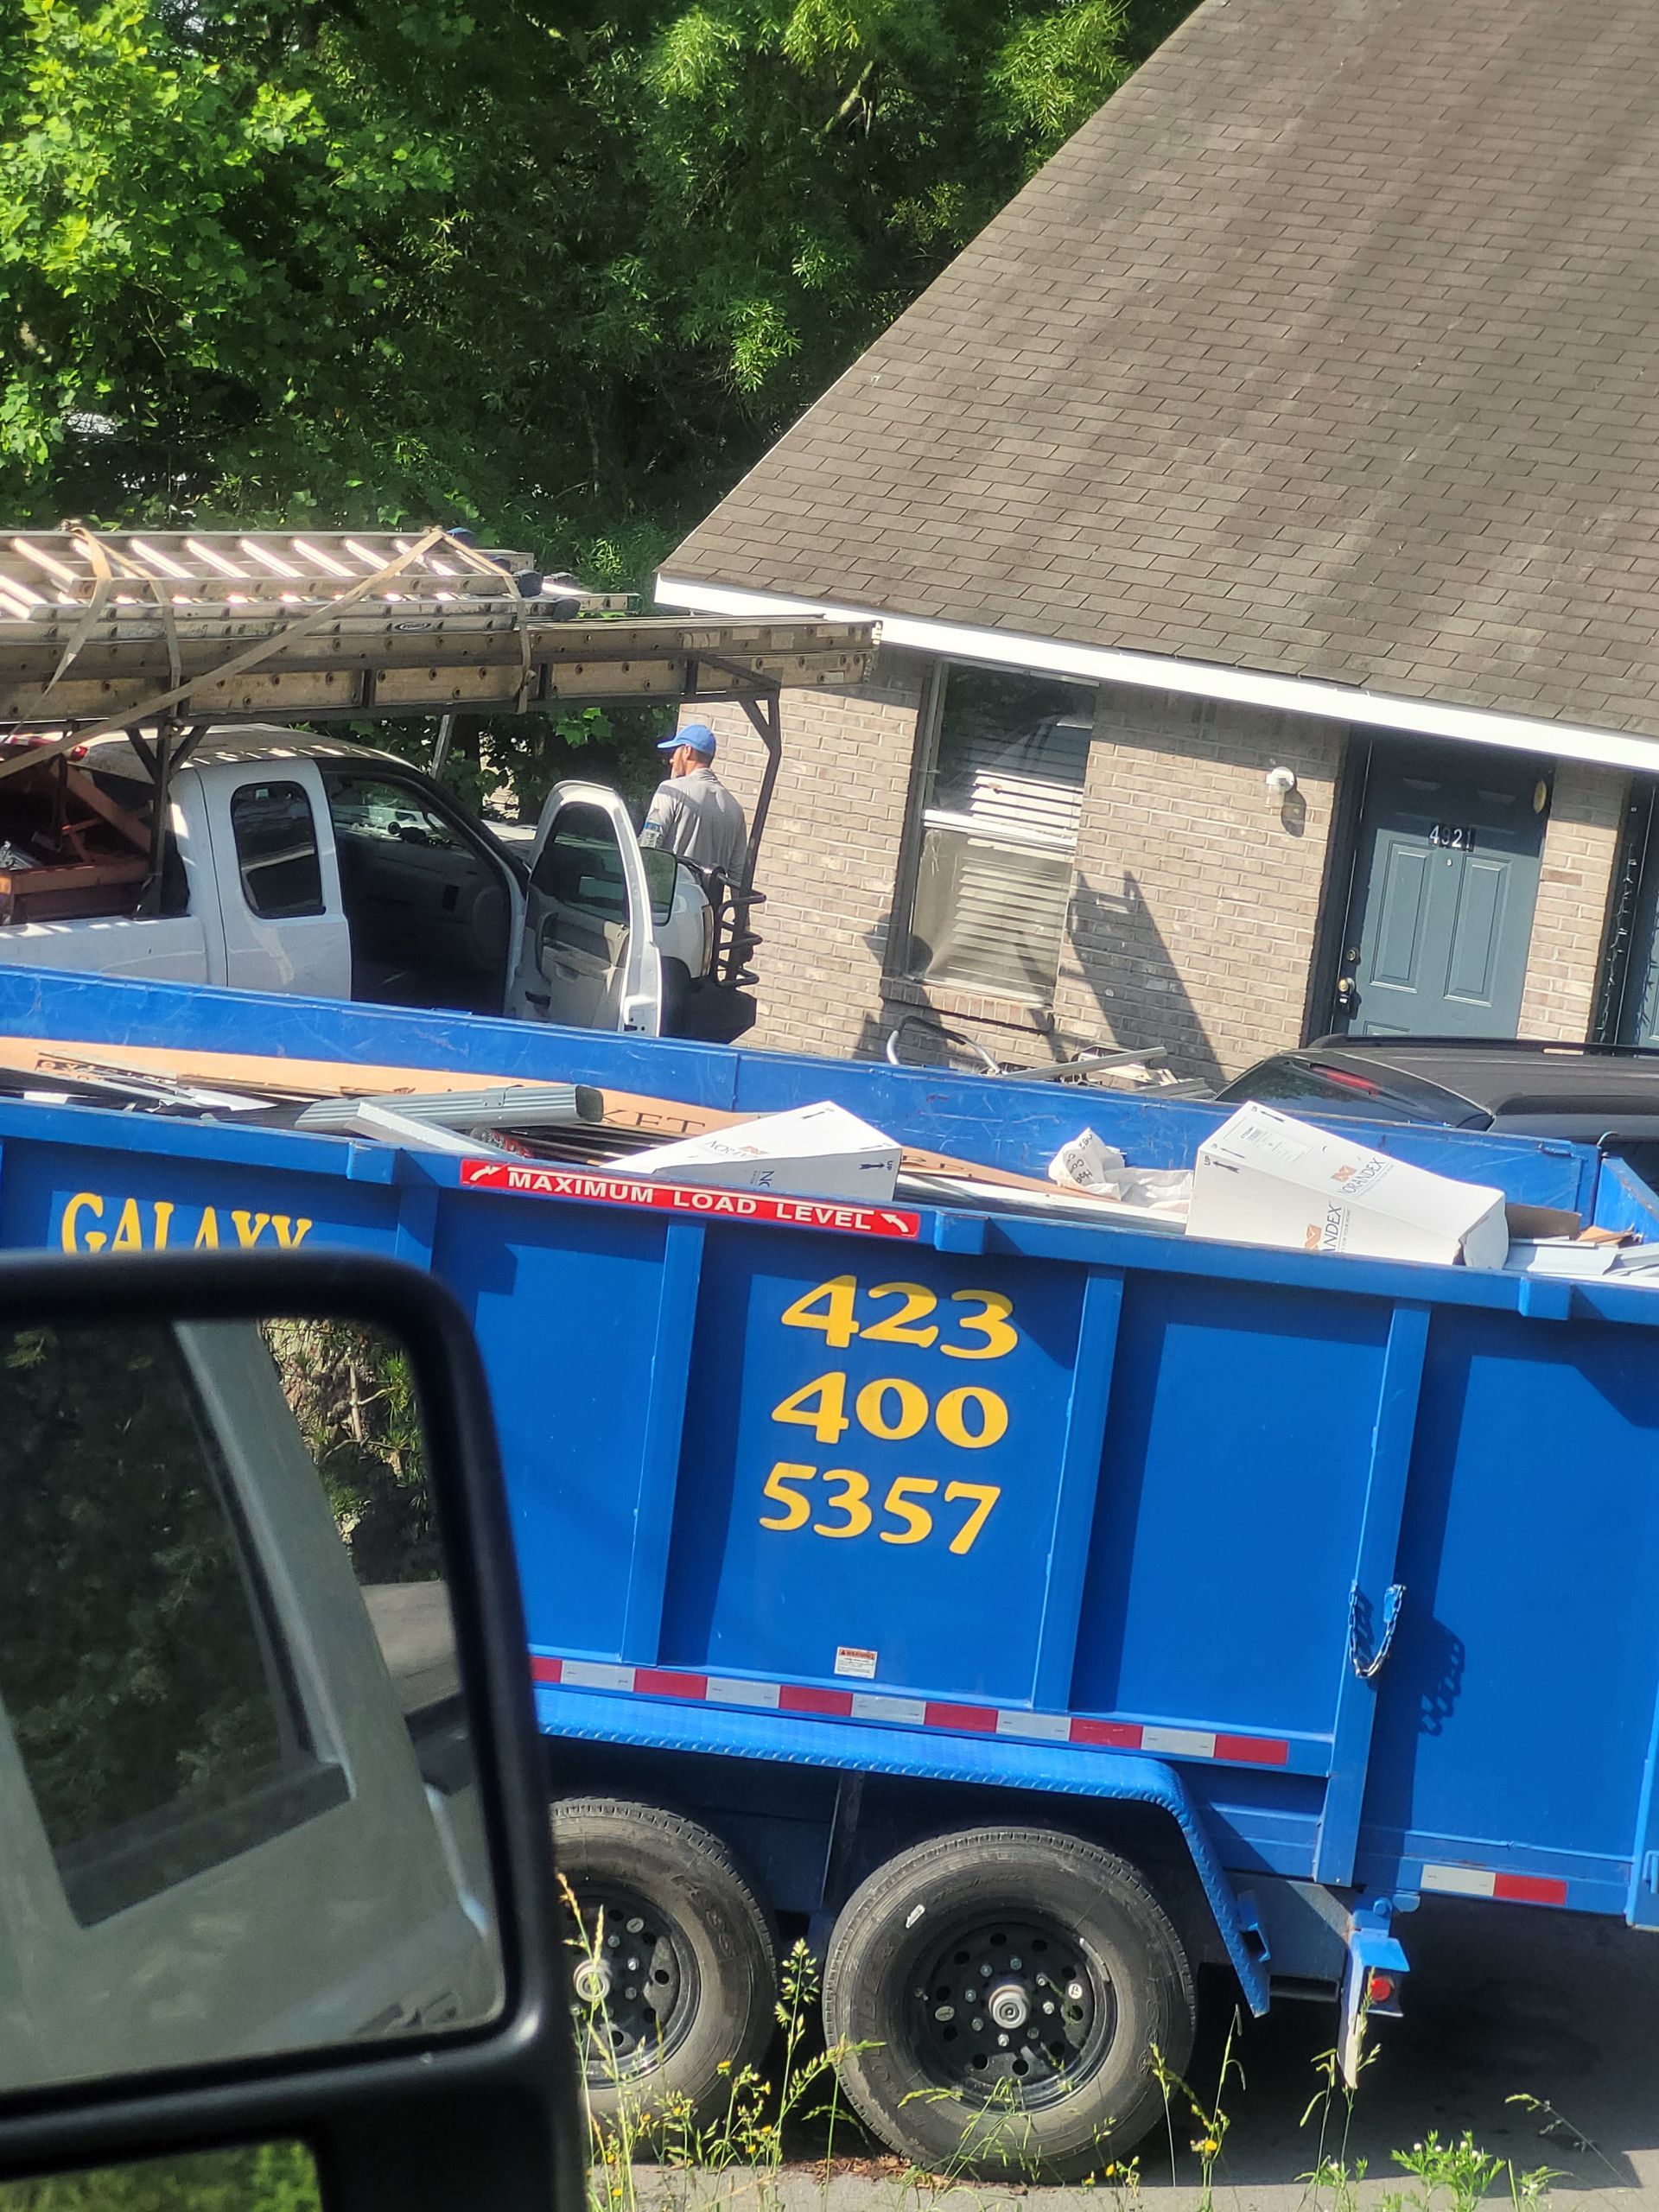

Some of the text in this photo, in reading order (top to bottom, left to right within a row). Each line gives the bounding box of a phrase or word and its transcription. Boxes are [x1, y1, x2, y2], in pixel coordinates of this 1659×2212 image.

[1429, 824, 1471, 849] 4921
[508, 1171, 872, 1230] MAXIMUM LOAD LEVEL
[780, 1274, 1019, 1360] 423
[771, 1371, 1009, 1449] 400
[759, 1461, 1001, 1555] 5357
